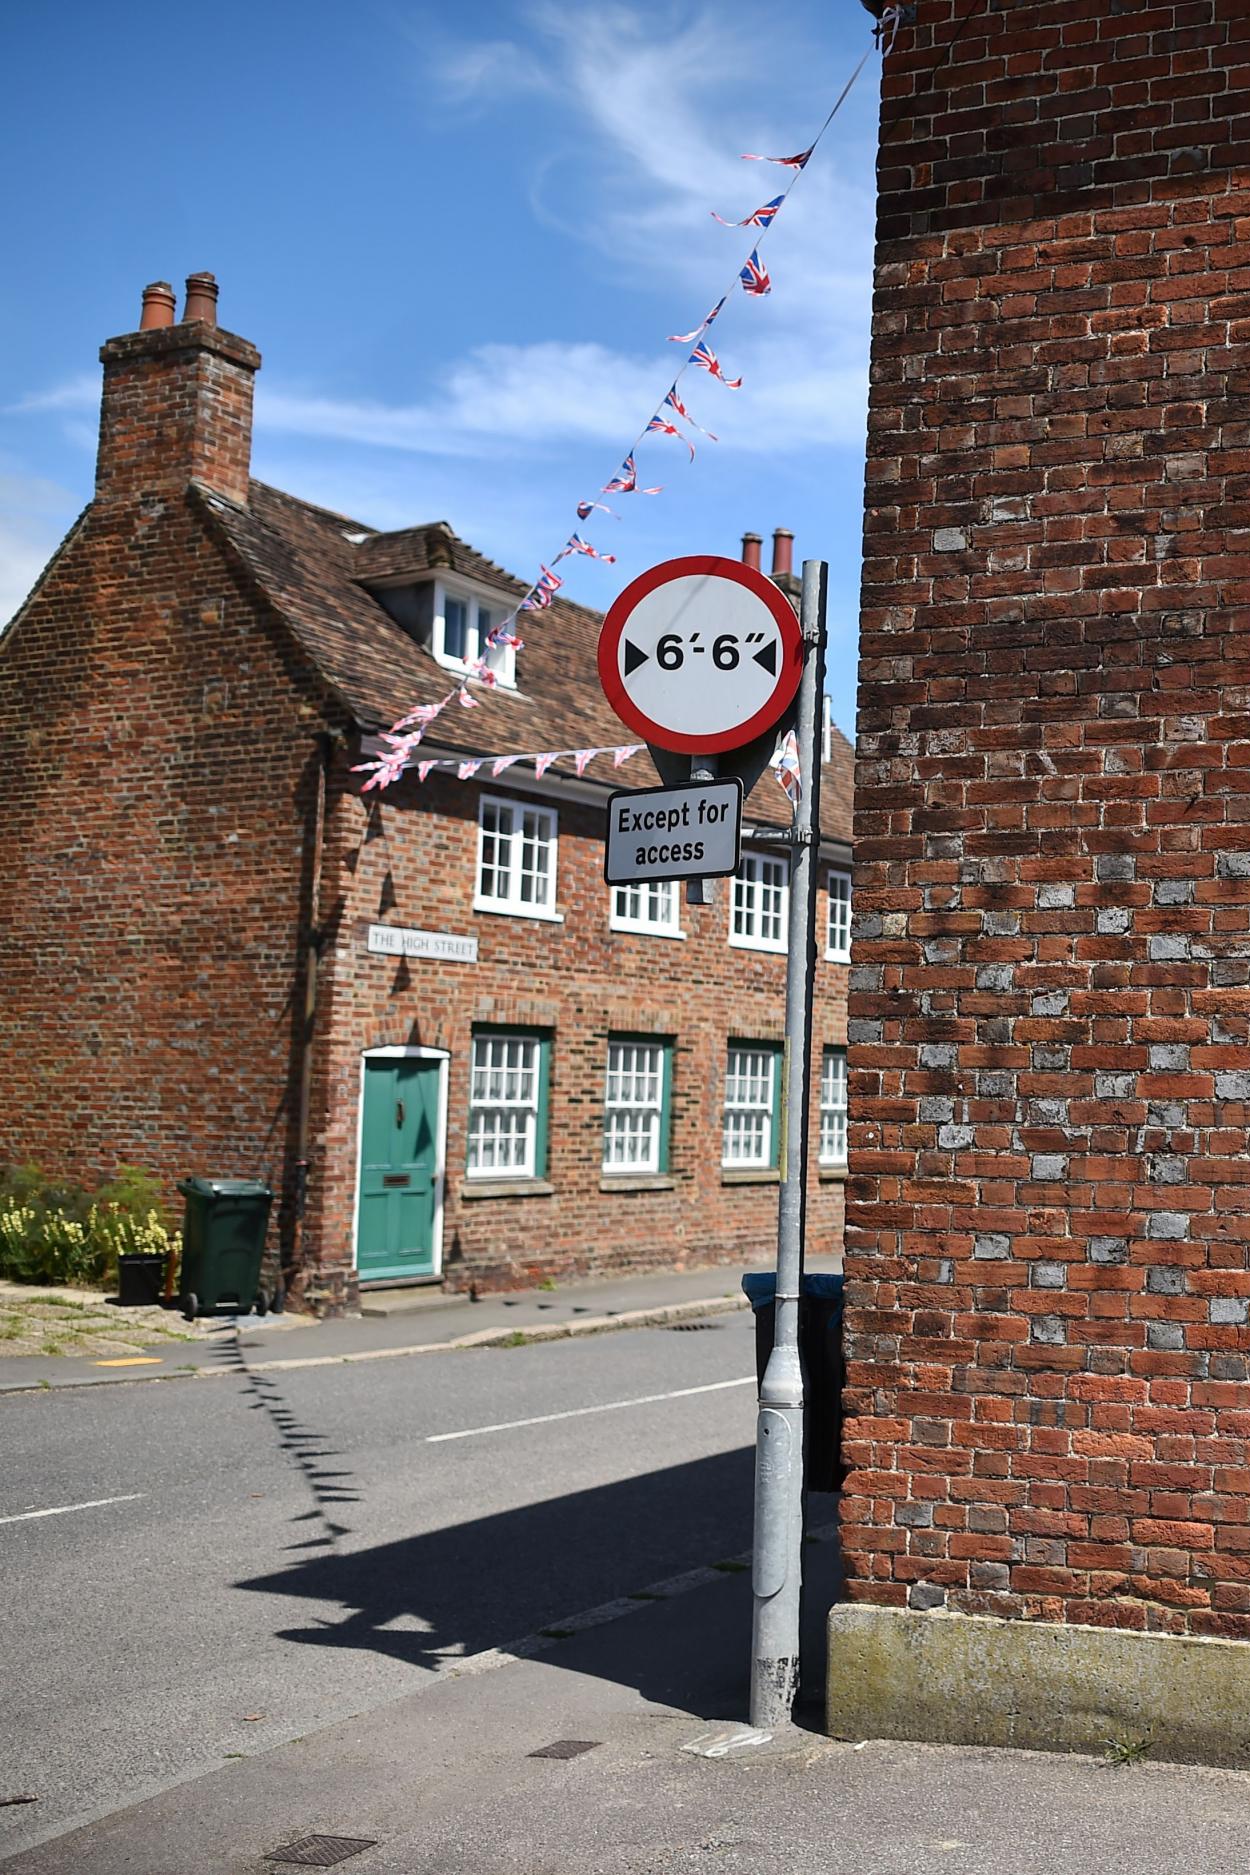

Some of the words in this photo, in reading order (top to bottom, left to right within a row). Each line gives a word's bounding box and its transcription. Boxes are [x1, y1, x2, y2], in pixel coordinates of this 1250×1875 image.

[618, 802, 690, 834] Except
[698, 799, 729, 824] for
[635, 840, 705, 866] access
[373, 932, 395, 949] THE
[401, 934, 430, 952] HIGH
[434, 940, 473, 956] STREET
